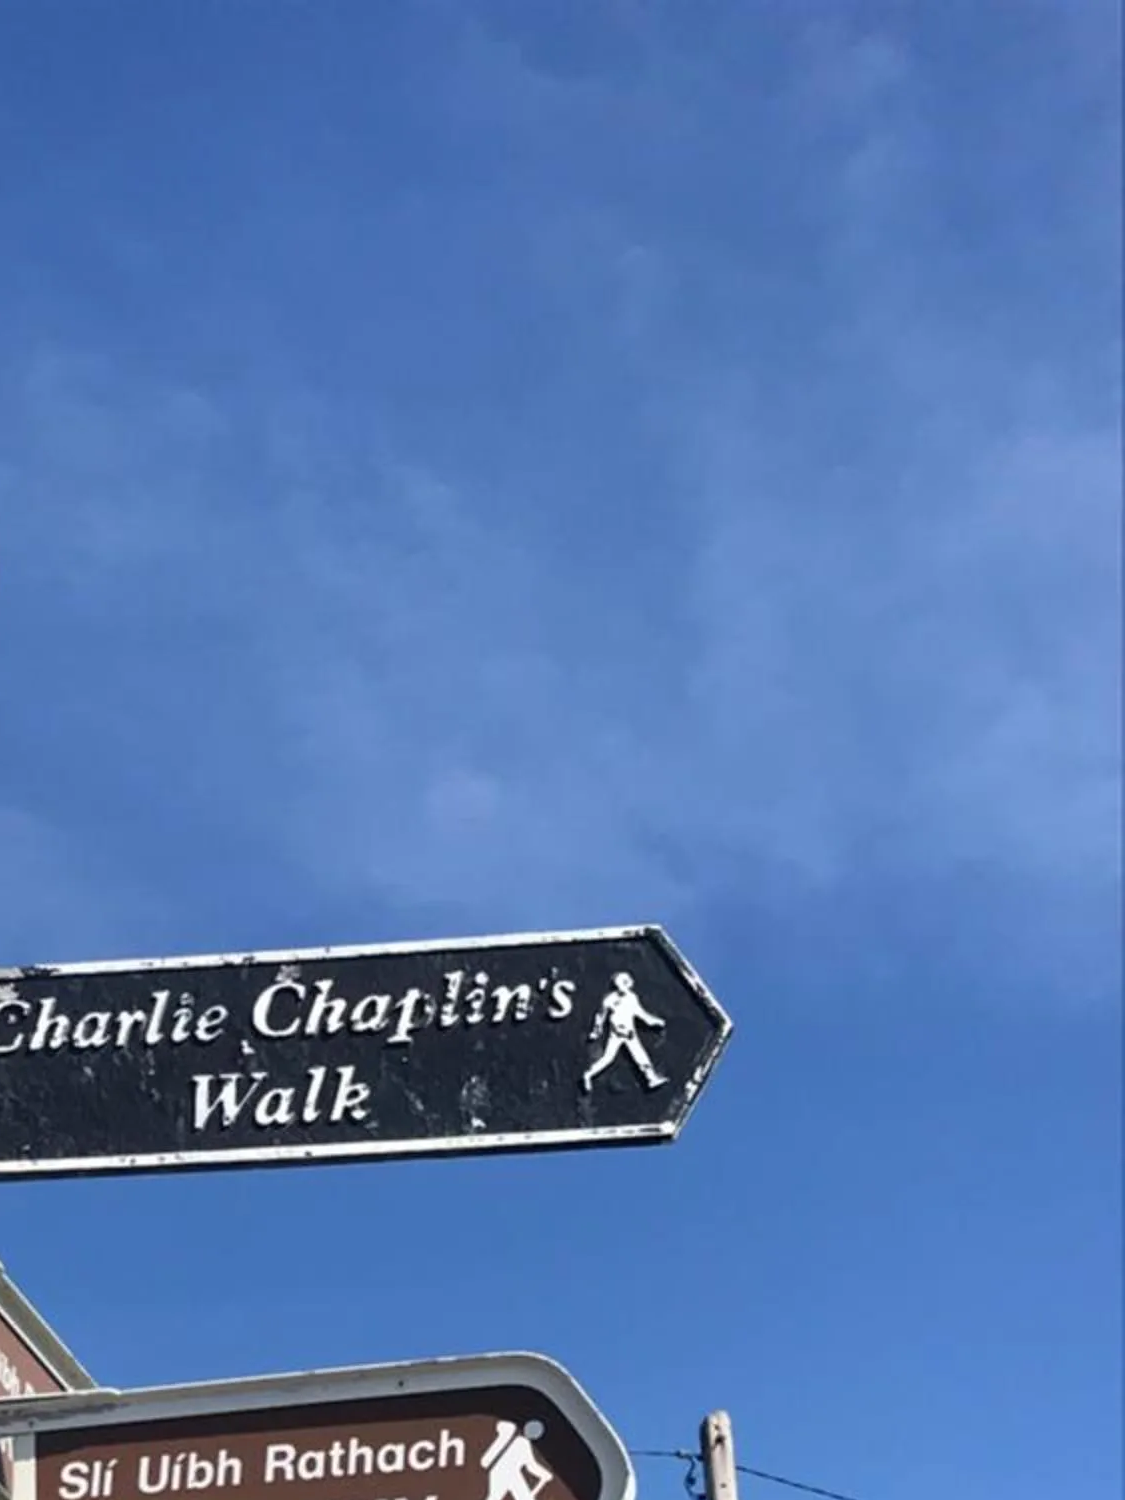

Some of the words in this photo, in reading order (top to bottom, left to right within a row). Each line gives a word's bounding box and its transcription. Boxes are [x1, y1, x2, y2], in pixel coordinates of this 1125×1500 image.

[251, 969, 576, 1045] Chaplin's
[192, 1066, 373, 1129] Walk
[58, 1459, 119, 1500] Slí
[137, 1448, 243, 1494] Uíbh
[264, 1428, 466, 1484] Rathach
